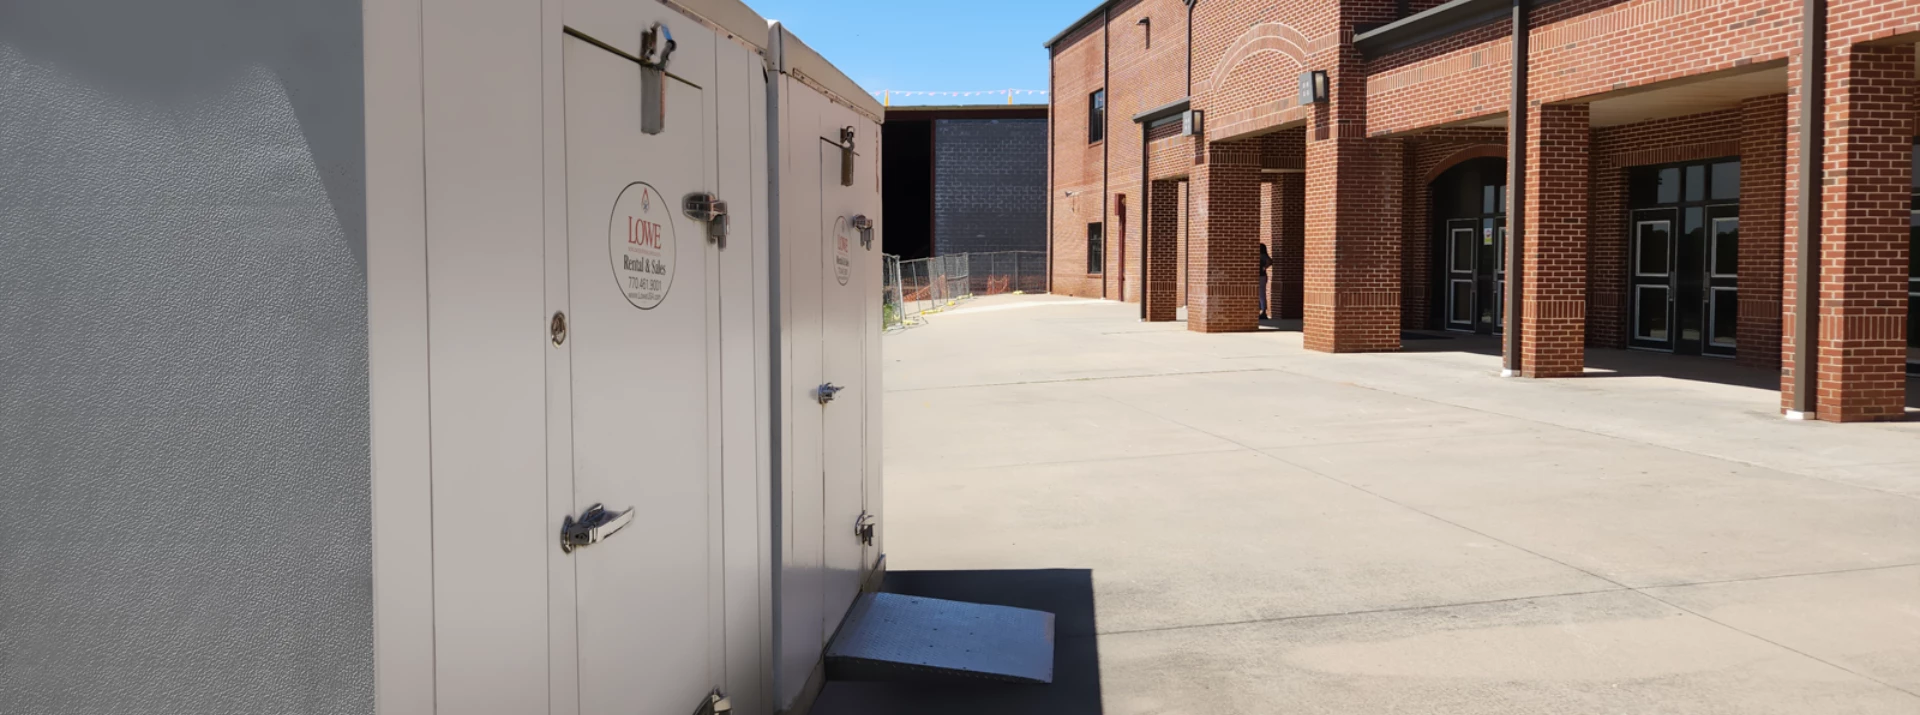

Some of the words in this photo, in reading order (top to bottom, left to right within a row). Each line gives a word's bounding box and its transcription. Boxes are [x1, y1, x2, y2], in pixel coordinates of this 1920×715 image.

[628, 216, 661, 249] LOWE
[624, 254, 644, 272] Rental
[645, 258, 650, 273] &
[651, 259, 666, 275] Sales
